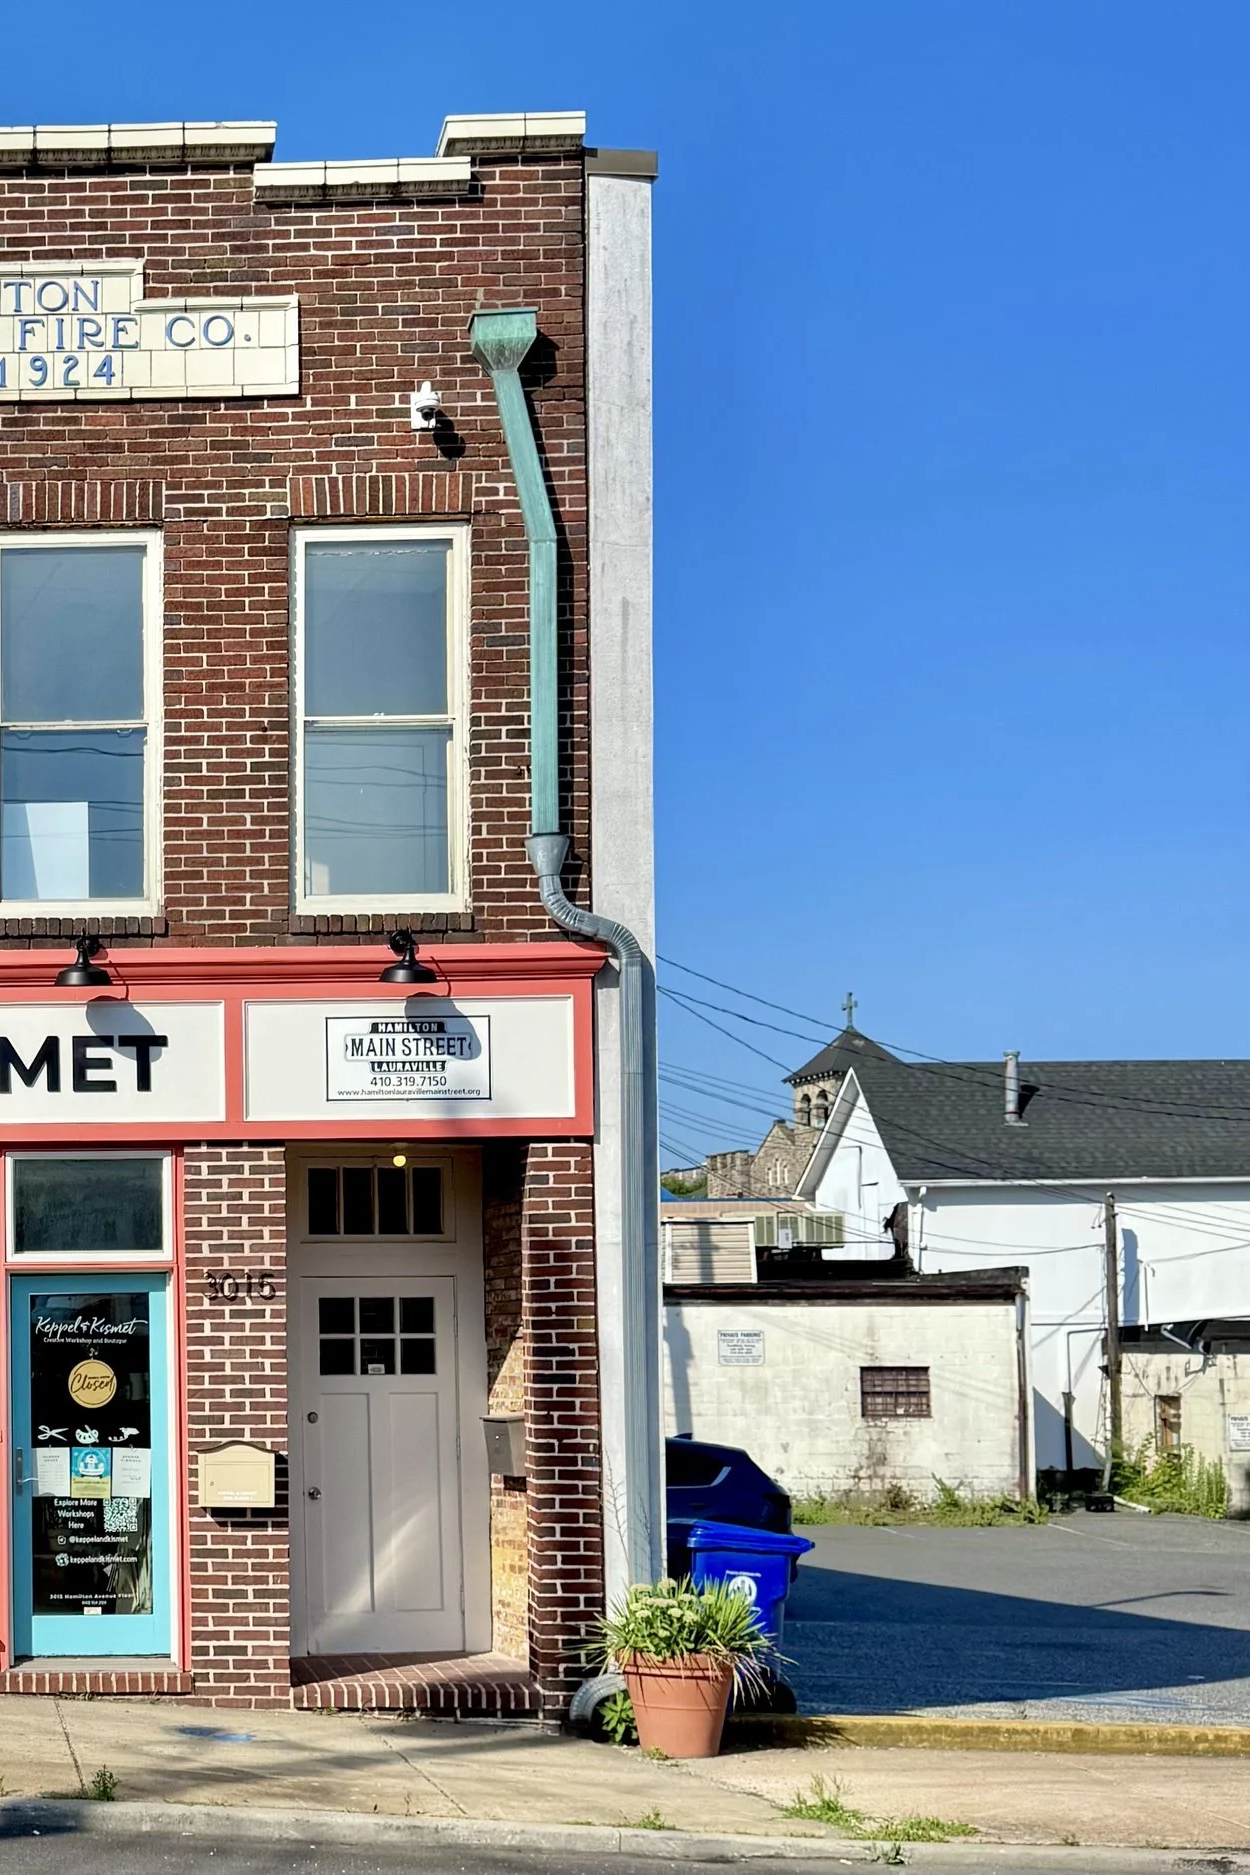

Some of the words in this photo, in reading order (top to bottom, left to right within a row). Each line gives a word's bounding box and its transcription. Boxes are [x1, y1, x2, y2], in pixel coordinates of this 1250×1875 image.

[18, 316, 139, 351] FIRE
[165, 313, 252, 348] CO.
[377, 1022, 438, 1033] HAMILTON
[350, 1037, 396, 1057] MAIN
[401, 1036, 467, 1057] STREET
[373, 1061, 444, 1072] LAURAVILLE
[370, 1075, 447, 1087] 410.319.7150
[337, 1088, 481, 1097] www.hamiltonlauravillemainstreet.org
[203, 1272, 277, 1302] 3015
[35, 1316, 82, 1340] Keppel
[89, 1316, 148, 1335] Kismet
[70, 1373, 115, 1394] Closed
[54, 1498, 79, 1508] Explore
[80, 1499, 97, 1507] More
[57, 1510, 95, 1519] Workshops
[68, 1521, 85, 1529] Here
